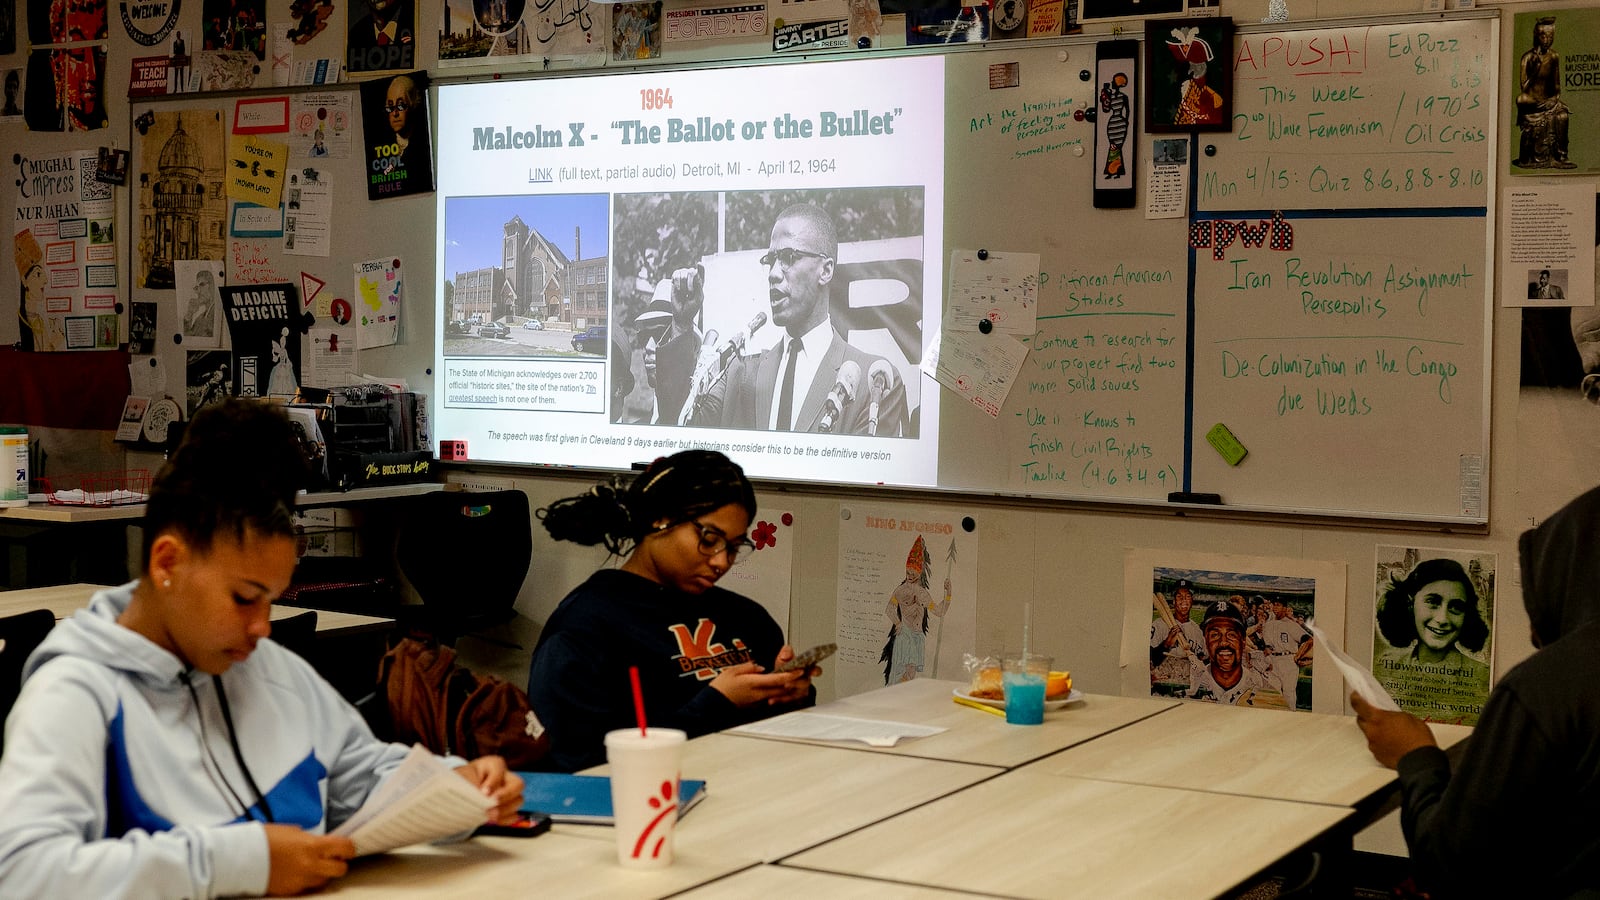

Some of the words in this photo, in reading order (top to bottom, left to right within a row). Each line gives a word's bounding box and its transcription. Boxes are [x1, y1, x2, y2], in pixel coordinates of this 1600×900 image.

[666, 10, 700, 18] PRESIDENT
[667, 16, 731, 38] FORD
[775, 24, 802, 36] JIMMY
[1032, 22, 1059, 33] NOW!
[350, 45, 412, 70] HOPE
[1234, 34, 1360, 72] APUSH
[139, 66, 166, 80] TEACH
[1566, 63, 1600, 71] MUSEUM
[132, 80, 147, 88] HARD
[1566, 72, 1600, 86] KORE
[640, 88, 674, 110] 1964
[1259, 86, 1296, 105] This
[970, 113, 992, 132] Art
[1002, 110, 1017, 119] the
[472, 124, 563, 150] Malcolm
[568, 122, 585, 147] X
[667, 117, 735, 142] Ballot
[742, 120, 767, 140] or
[774, 114, 813, 139] the
[1001, 118, 1015, 134] of
[1017, 116, 1053, 130] feeling
[1017, 123, 1066, 140] perspective
[1268, 113, 1302, 140] Wave
[1405, 124, 1432, 144] Oil
[1440, 126, 1486, 142] Crisis
[245, 145, 264, 157] YOU'RE
[264, 150, 273, 159] ON
[374, 143, 400, 158] TOO
[29, 158, 75, 174] MUGHAL
[372, 156, 404, 171] COOL
[528, 167, 553, 183] LINK
[559, 167, 577, 182] (full
[580, 168, 603, 181] text,
[606, 165, 639, 182] partial
[642, 164, 676, 180] audio)
[682, 162, 724, 176] Detroit,
[727, 162, 741, 175] MI
[758, 160, 784, 177] April
[789, 160, 804, 175] 12,
[808, 158, 836, 173] 1964
[21, 158, 74, 202] Empress
[371, 170, 408, 184] BRITISH
[1204, 172, 1238, 201] Mon
[1309, 165, 1350, 193] Quiz
[255, 184, 270, 194] LAND
[378, 182, 402, 194] RULE
[16, 206, 43, 221] NUR
[45, 203, 80, 219] JAHAN
[362, 262, 383, 272] PERSIA
[1228, 259, 1270, 290] Iran
[1285, 258, 1372, 290] Revolution
[1384, 264, 1474, 317] Assignment
[232, 290, 286, 306] MADAME
[1065, 292, 1124, 312] Studies
[1302, 291, 1386, 318] Persepolis
[230, 304, 288, 321] DEFICIT!
[1034, 330, 1079, 351] Continue
[1102, 331, 1151, 348] research
[1156, 328, 1175, 347] for
[1061, 356, 1110, 378] project
[1116, 352, 1143, 373] find
[1149, 356, 1175, 368] two
[449, 368, 461, 377] The
[462, 368, 478, 377] State
[479, 369, 486, 377] of
[487, 369, 514, 379] Michigan
[516, 370, 561, 380] acknowledges
[579, 371, 598, 380] 2,700
[1355, 356, 1367, 375] in
[1376, 349, 1399, 374] the
[1406, 346, 1457, 404] Congo
[586, 385, 596, 394] 7th
[448, 394, 474, 403] greatest
[475, 395, 497, 403] speech
[538, 396, 556, 404] them.
[1278, 385, 1304, 416] due
[1026, 408, 1046, 426] Use
[488, 430, 501, 440] The
[503, 432, 527, 442] speech
[529, 433, 544, 441] was
[545, 432, 558, 442] first
[559, 434, 579, 445] given
[580, 435, 587, 444] in
[590, 435, 625, 446] Cleveland
[628, 437, 632, 446] 9
[634, 437, 651, 448] days
[653, 439, 677, 448] earlier
[679, 440, 691, 449] but
[693, 440, 730, 451] historians
[732, 443, 766, 453] consider
[767, 444, 781, 454] this
[784, 446, 791, 455] to
[794, 445, 803, 455] be
[806, 446, 819, 456] the
[821, 447, 858, 459] definitive
[860, 450, 891, 461] version
[1071, 440, 1101, 458] Civil
[1105, 438, 1152, 472] Rights
[382, 465, 396, 475] BUCK
[396, 464, 412, 474] STOPS
[1020, 462, 1068, 484] Timeline
[1415, 665, 1474, 677] wonderful
[1414, 685, 1451, 694] moment
[1394, 698, 1428, 708] mprove
[1431, 700, 1447, 710] the
[1449, 704, 1480, 714] world
